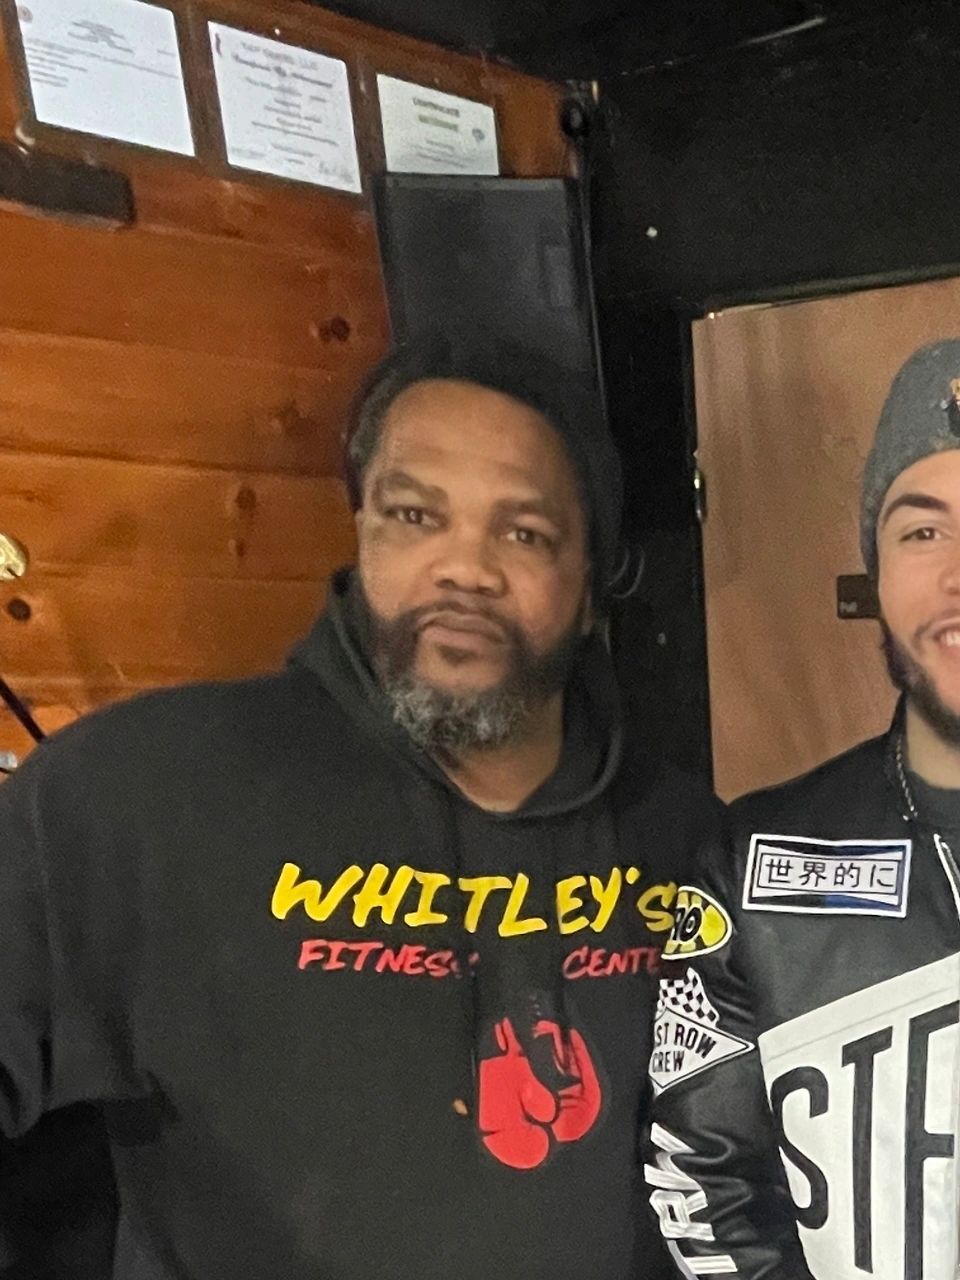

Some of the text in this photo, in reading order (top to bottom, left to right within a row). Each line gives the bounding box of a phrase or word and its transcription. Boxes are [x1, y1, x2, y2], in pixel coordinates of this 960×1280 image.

[765, 858, 894, 888] 世界的に
[271, 862, 677, 938] WHITLEY'S
[673, 1023, 717, 1059] ROW
